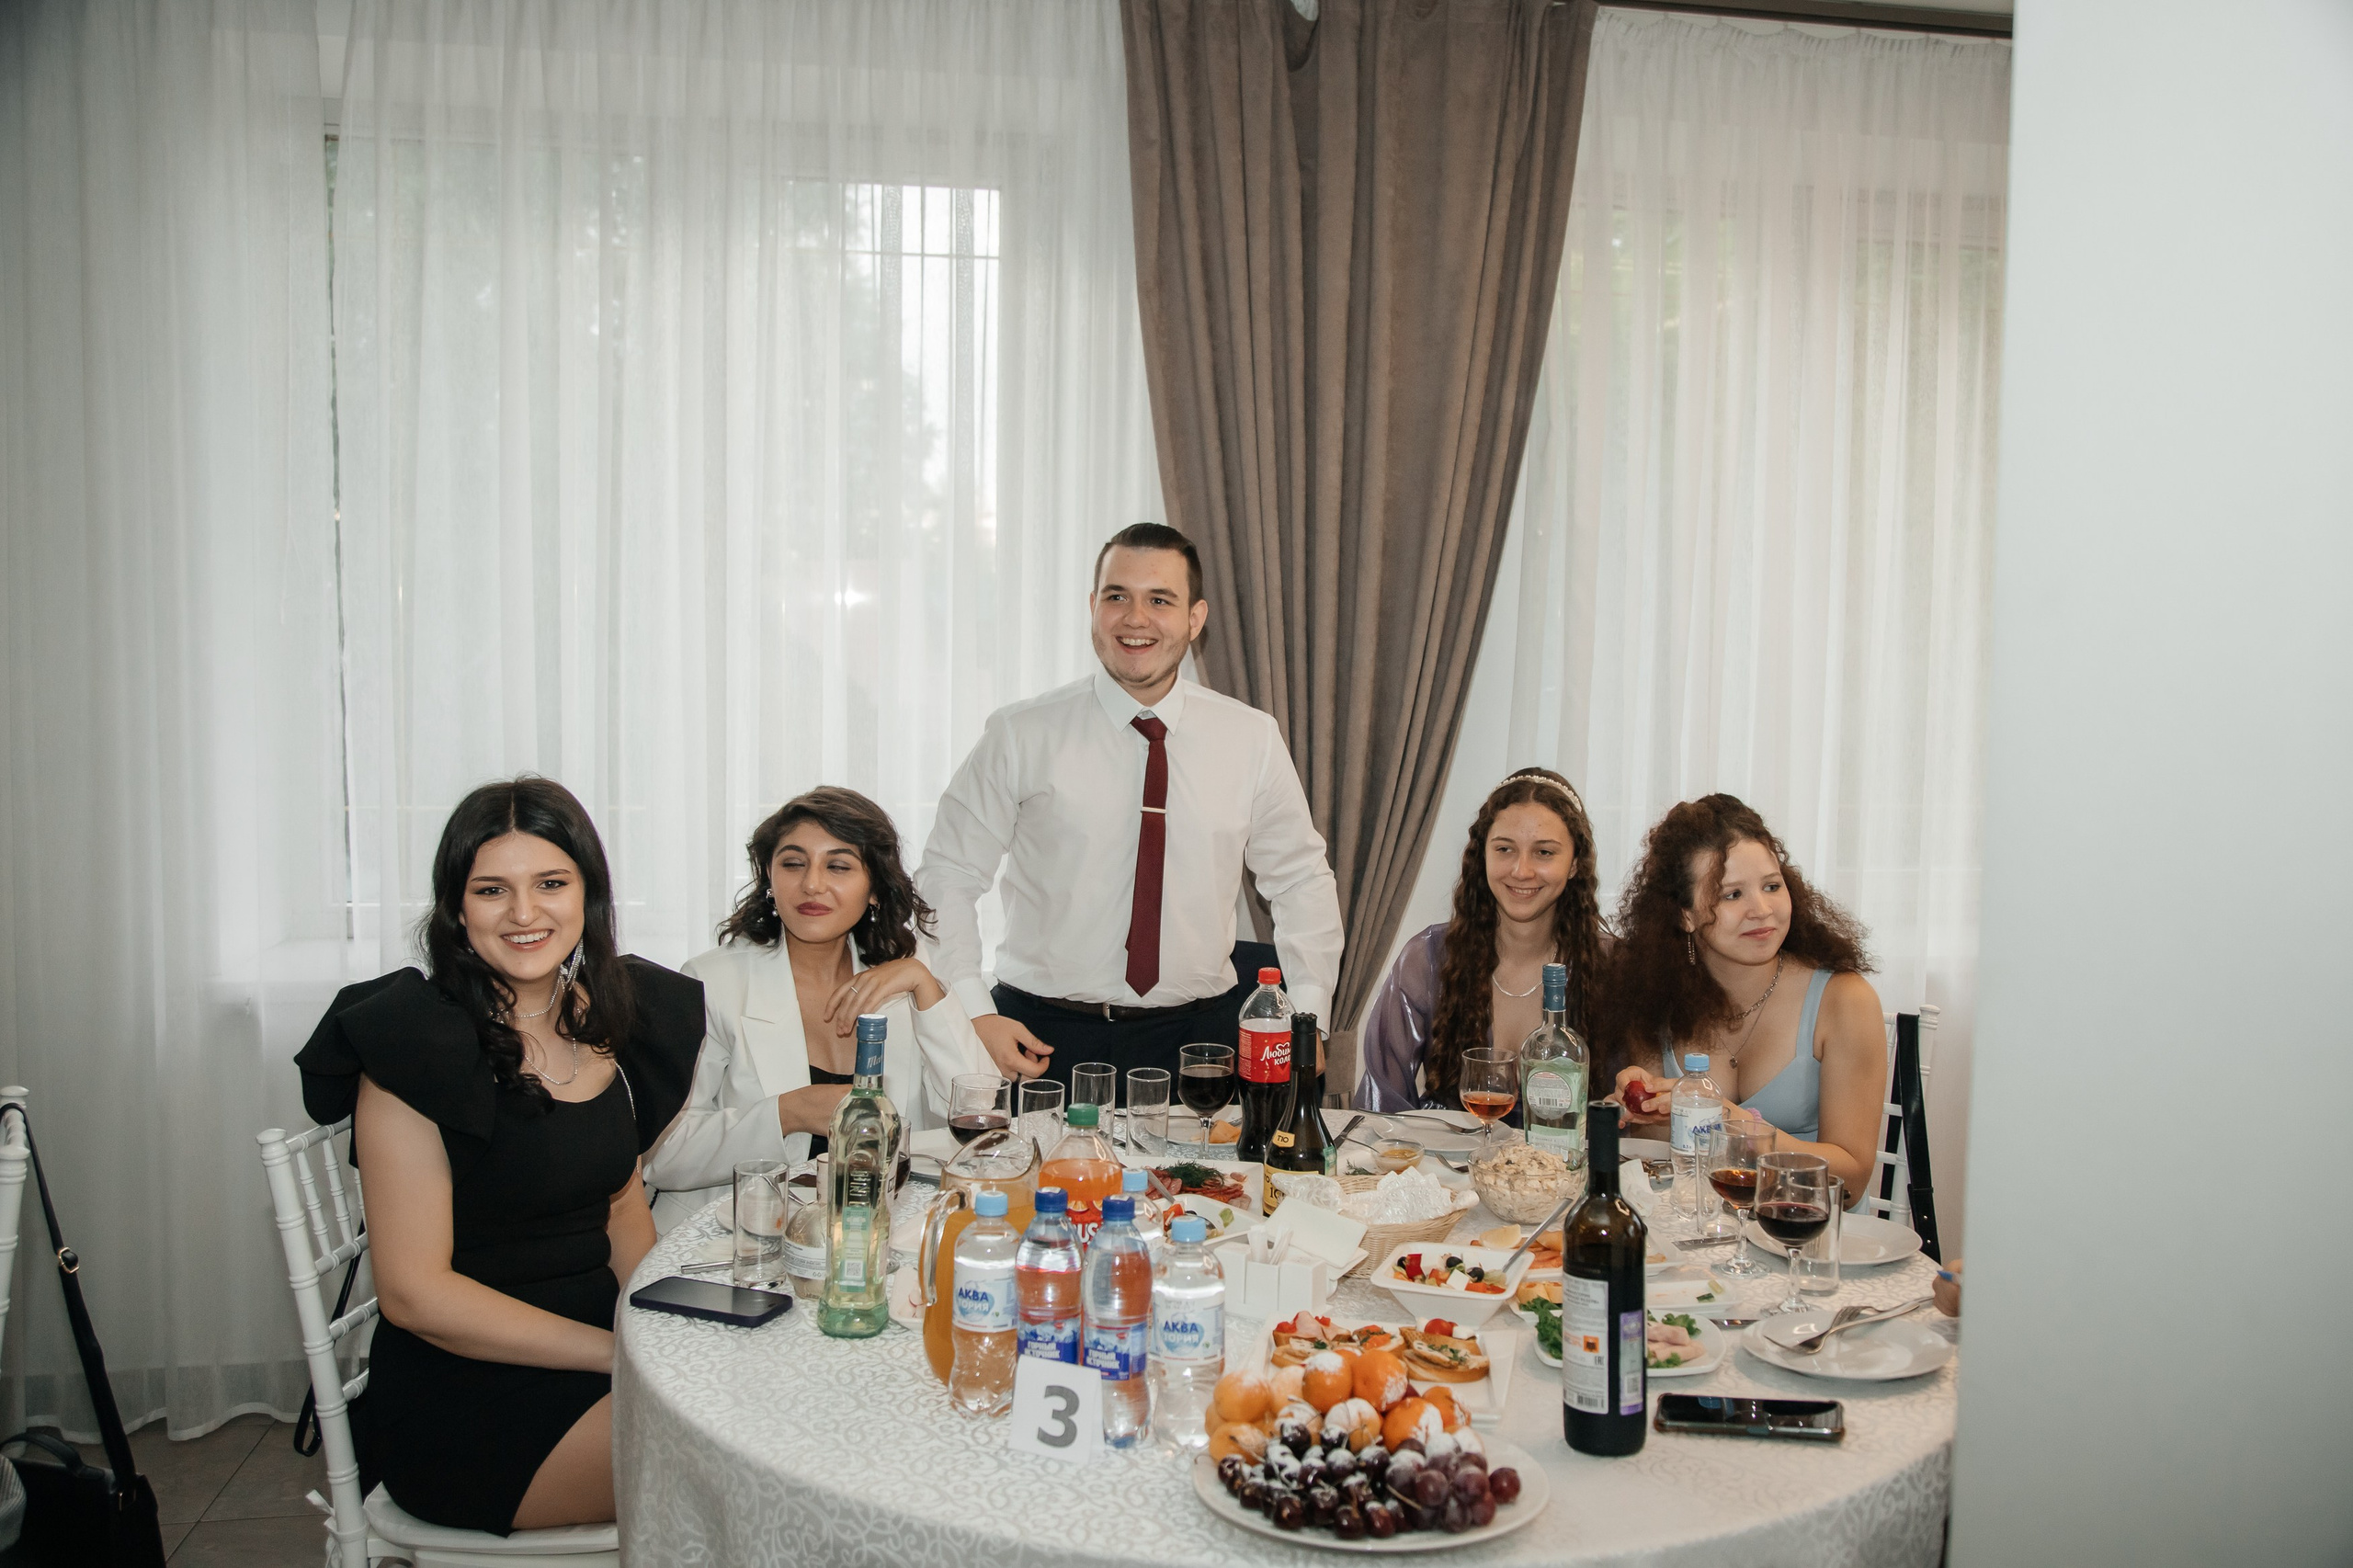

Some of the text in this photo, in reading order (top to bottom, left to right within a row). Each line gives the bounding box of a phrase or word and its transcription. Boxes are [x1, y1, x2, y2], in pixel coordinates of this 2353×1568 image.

[958, 1287, 989, 1301] АКВА
[1163, 1320, 1199, 1334] АКВА
[1037, 1385, 1080, 1449] 3
